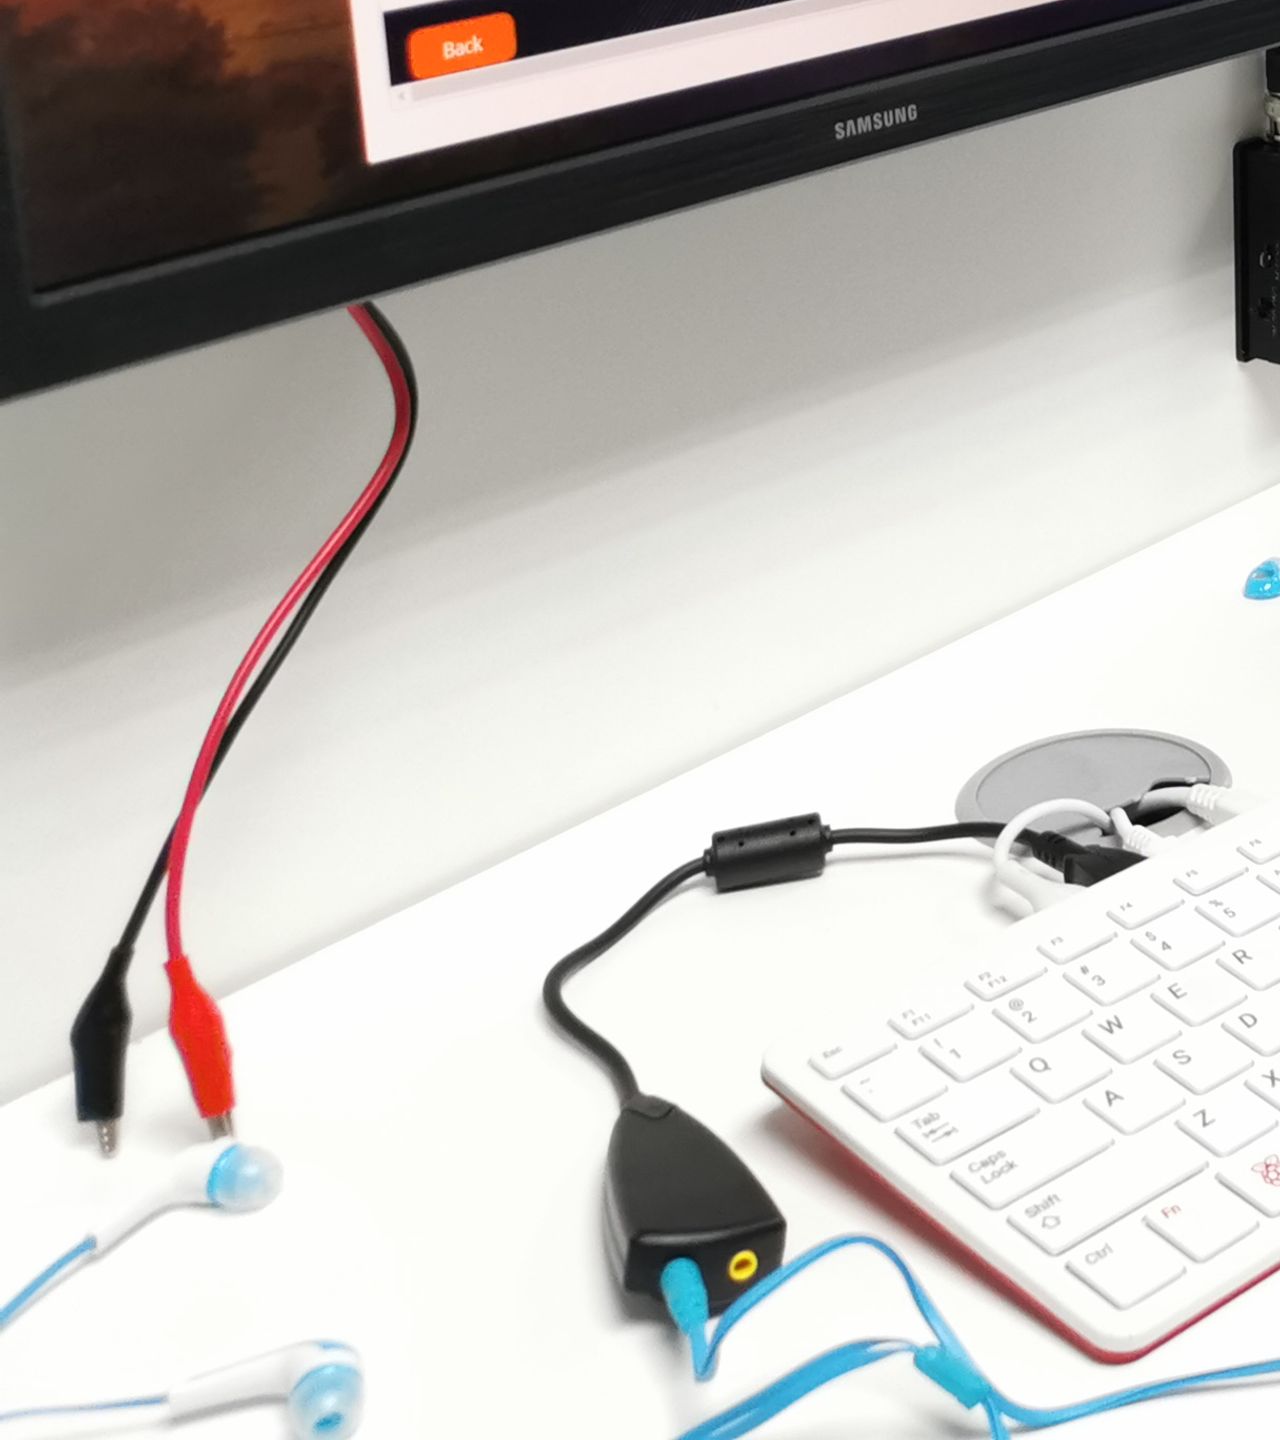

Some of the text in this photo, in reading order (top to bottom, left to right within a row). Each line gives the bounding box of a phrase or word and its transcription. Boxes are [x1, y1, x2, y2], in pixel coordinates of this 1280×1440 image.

[442, 34, 485, 61] Back
[834, 103, 918, 140] SAMSUNG
[1222, 907, 1236, 918] 5
[1161, 940, 1172, 951] 4
[1231, 949, 1252, 965] R
[1091, 974, 1106, 986] 3
[1167, 982, 1187, 1000] E
[1021, 1010, 1037, 1024] 2
[1098, 1014, 1124, 1034] W
[1238, 1012, 1258, 1029] D
[949, 1048, 962, 1059] 1
[1172, 1049, 1192, 1065] S
[1028, 1057, 1052, 1073] Q
[1104, 1090, 1124, 1107] A
[911, 1112, 940, 1129] Tab
[1192, 1108, 1215, 1128] Z
[967, 1150, 1006, 1173] Caps
[980, 1160, 1018, 1185] Lock
[1024, 1194, 1061, 1218] Shift
[1160, 1204, 1182, 1219] Fn
[1084, 1242, 1114, 1265] Ctrl
